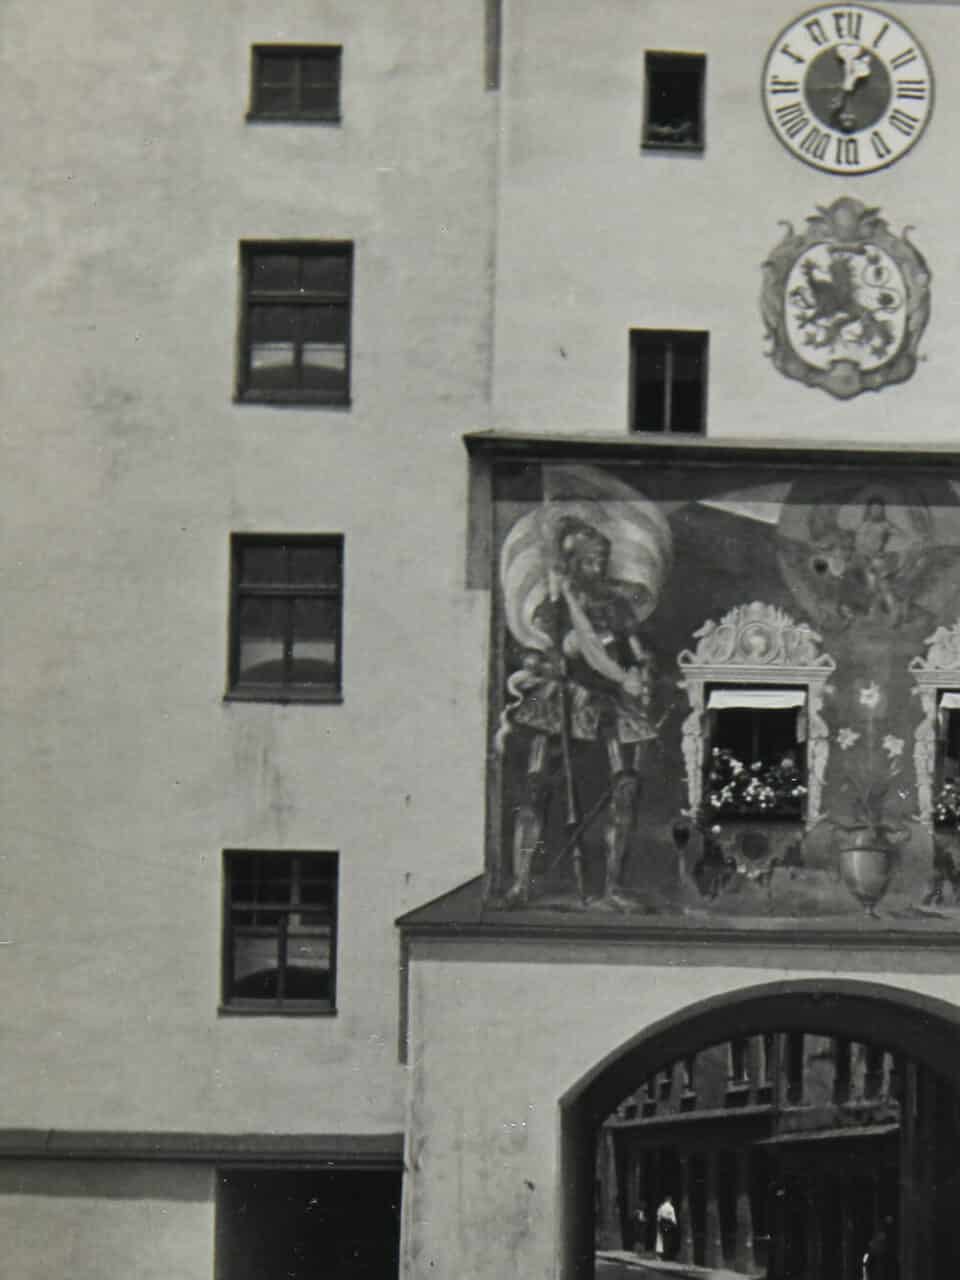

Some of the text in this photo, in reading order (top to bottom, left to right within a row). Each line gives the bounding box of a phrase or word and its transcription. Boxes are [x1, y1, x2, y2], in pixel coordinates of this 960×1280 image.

[872, 22, 890, 48] I
[889, 47, 918, 71] II
[896, 79, 926, 100] III
[869, 130, 893, 158] V
